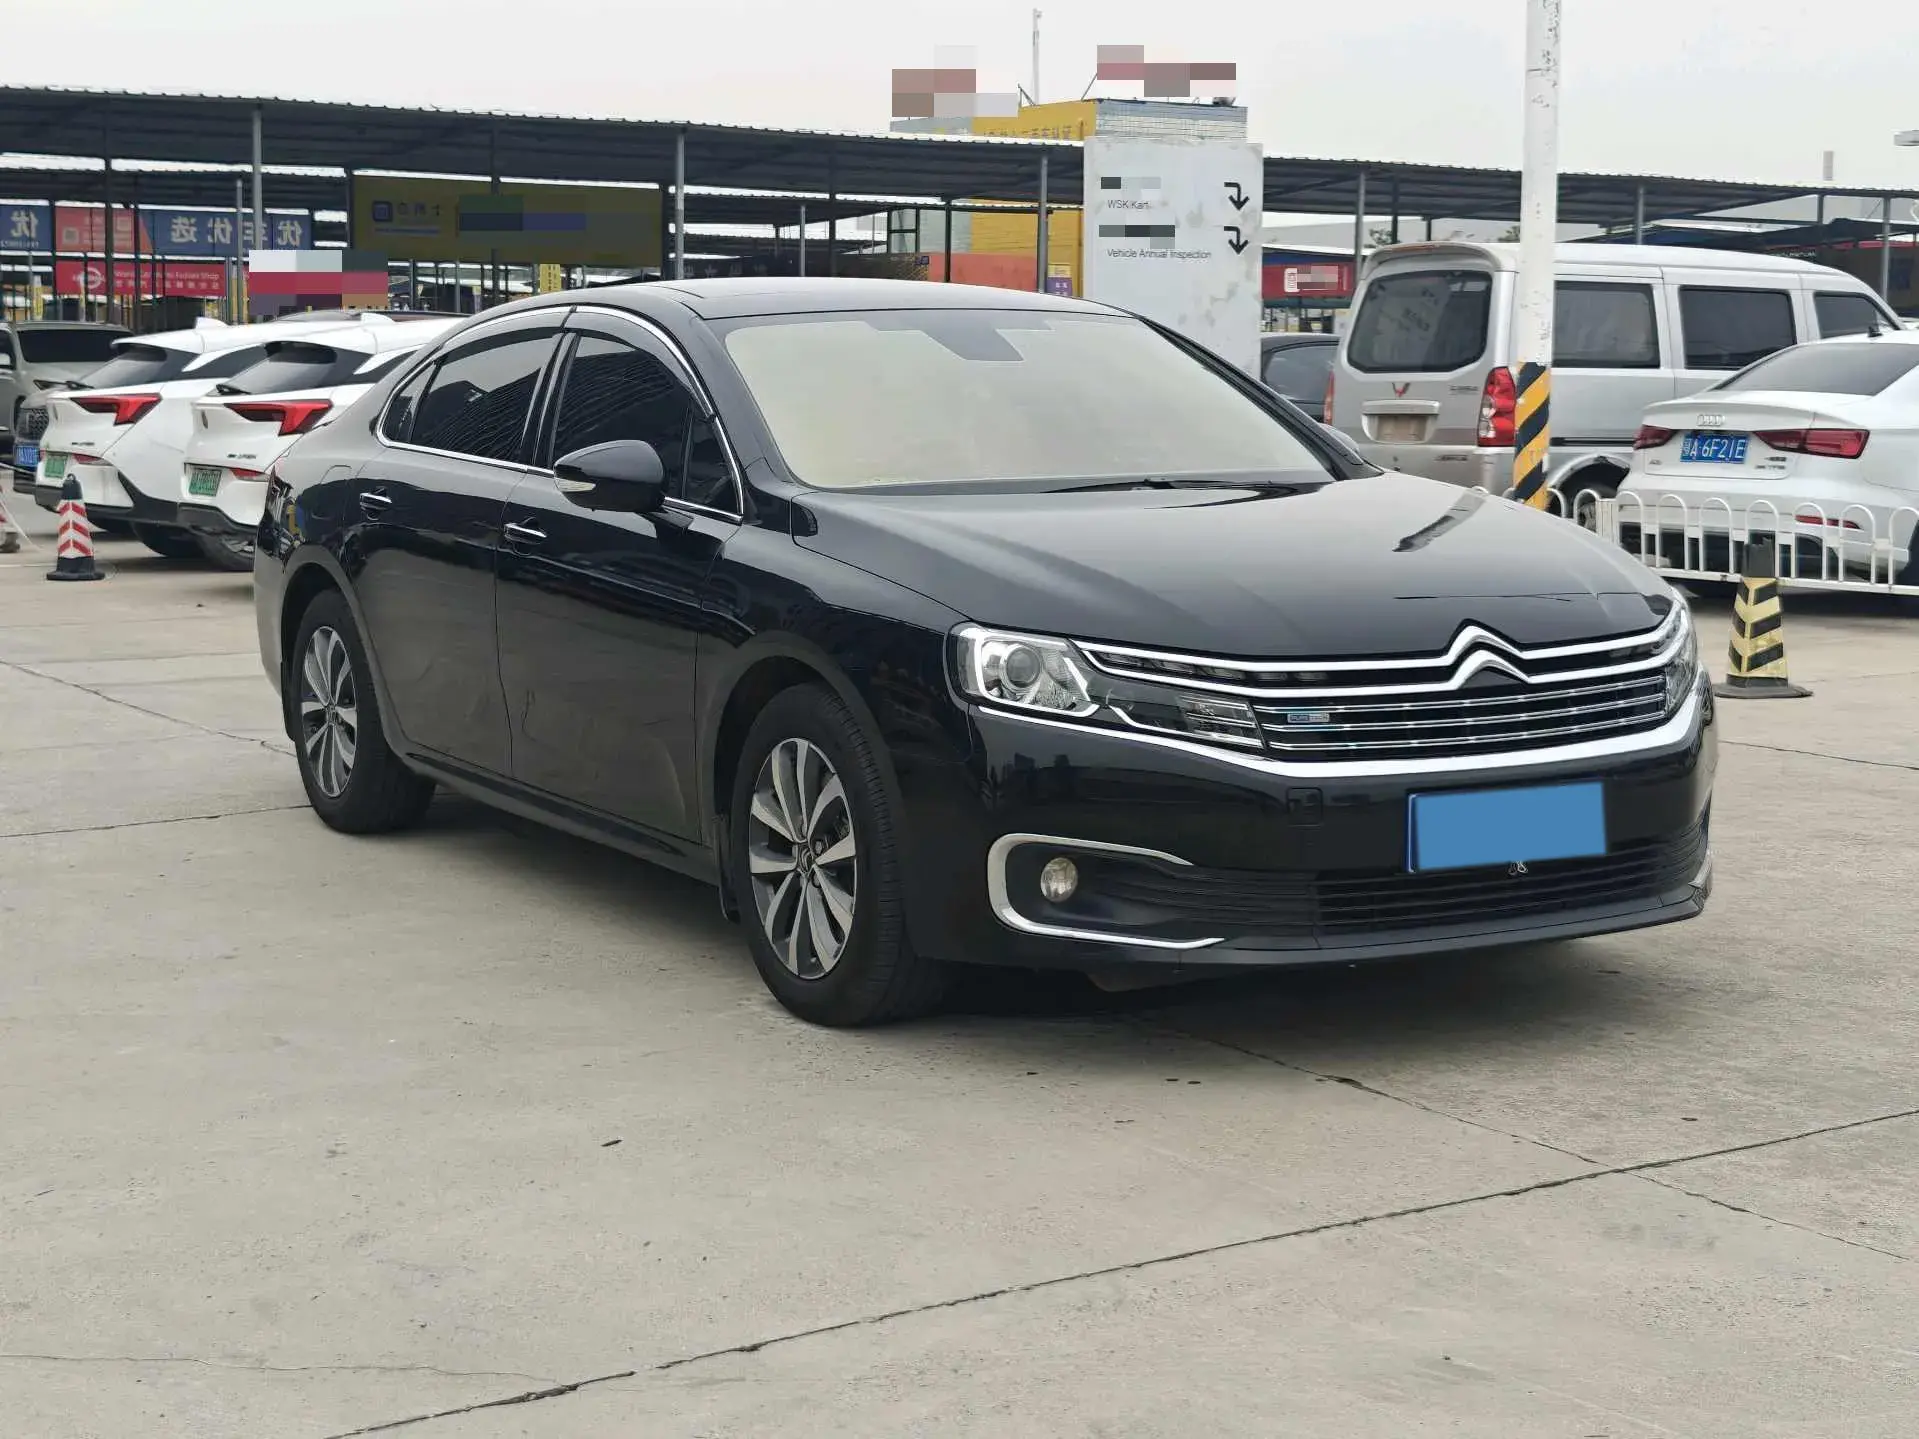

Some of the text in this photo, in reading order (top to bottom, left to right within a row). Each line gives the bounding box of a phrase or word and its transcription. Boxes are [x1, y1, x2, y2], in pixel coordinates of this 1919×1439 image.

[1107, 200, 1129, 209] WSK
[1107, 249, 1138, 258] Vehicle
[1170, 250, 1212, 260] Inspection
